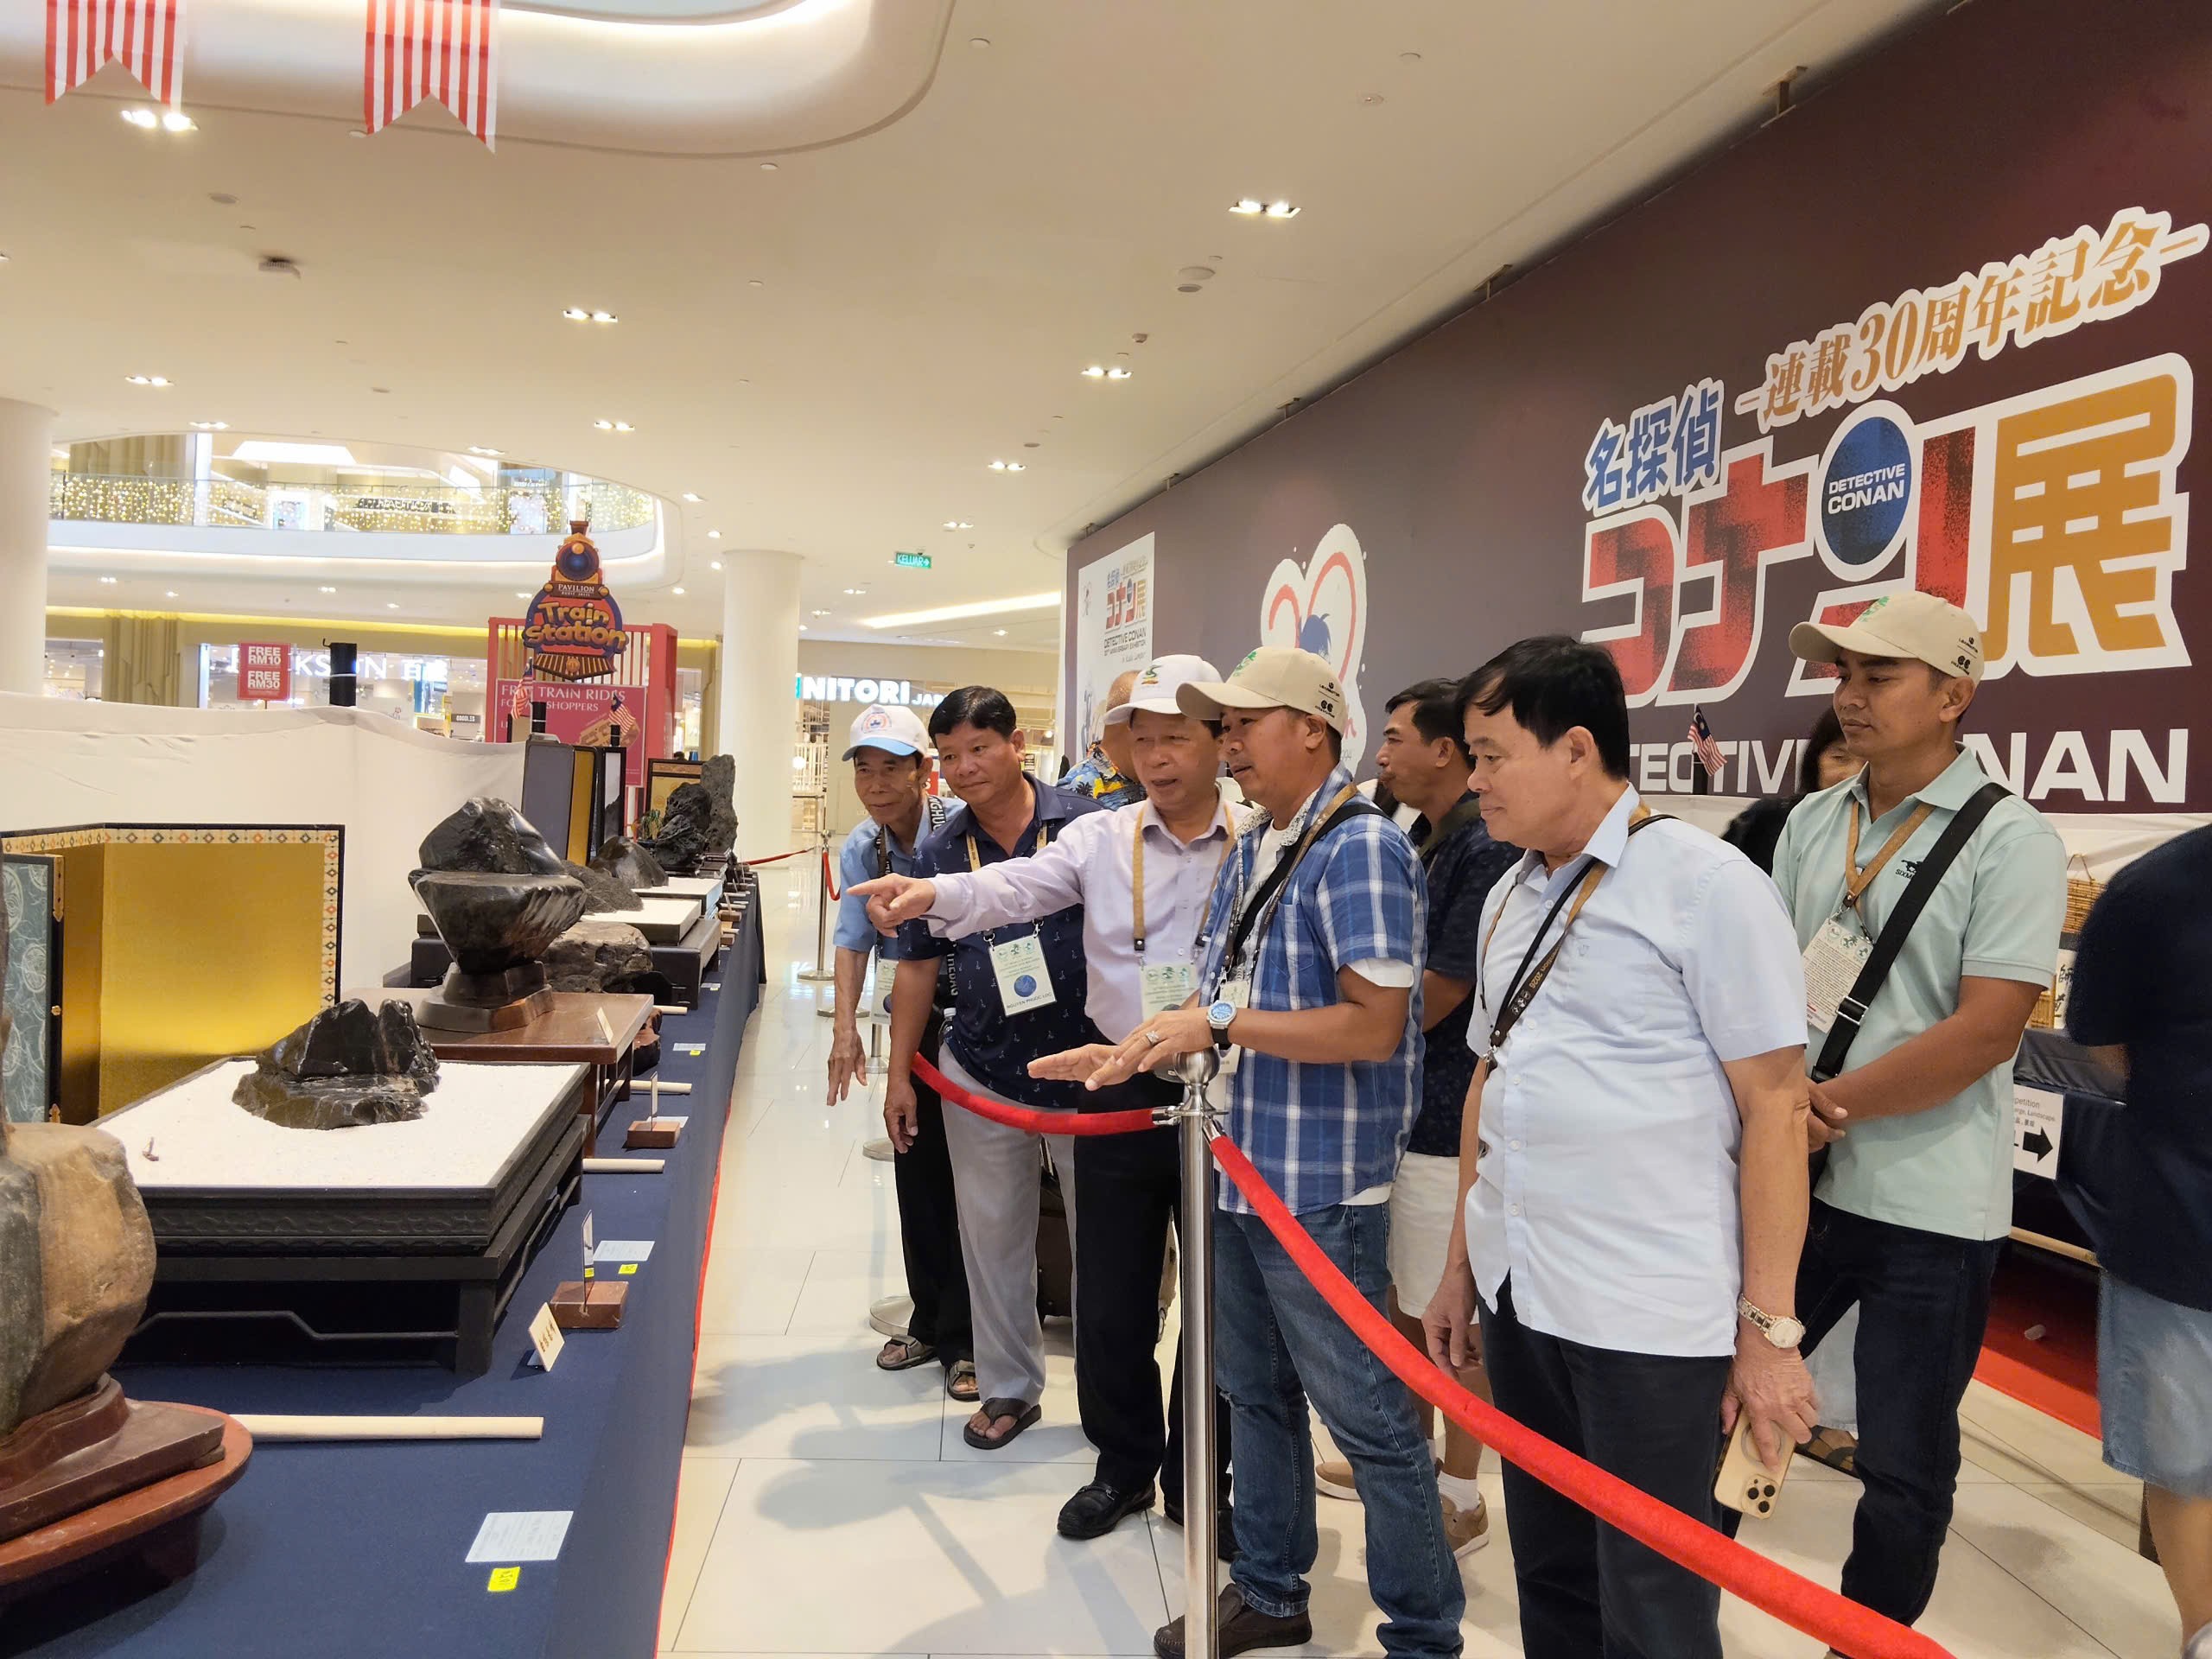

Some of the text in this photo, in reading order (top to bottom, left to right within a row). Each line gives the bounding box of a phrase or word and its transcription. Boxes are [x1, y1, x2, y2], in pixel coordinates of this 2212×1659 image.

[1586, 385, 1722, 509] 名探偵
[1828, 463, 1906, 494] DETECTIVE
[1827, 480, 1905, 514] CONAN
[557, 583, 594, 593] PAVILION
[537, 601, 610, 626] Train
[248, 645, 282, 657] FREE
[248, 655, 282, 665] RM10
[247, 670, 281, 681] FREE
[247, 679, 281, 690] RM30
[802, 677, 911, 705] NITORI
[538, 686, 581, 700] TRAIN
[546, 701, 599, 712] SHOPPERS
[1962, 728, 2189, 804] NAN
[1529, 971, 1543, 989] 2026
[2014, 1097, 2040, 1109] petition
